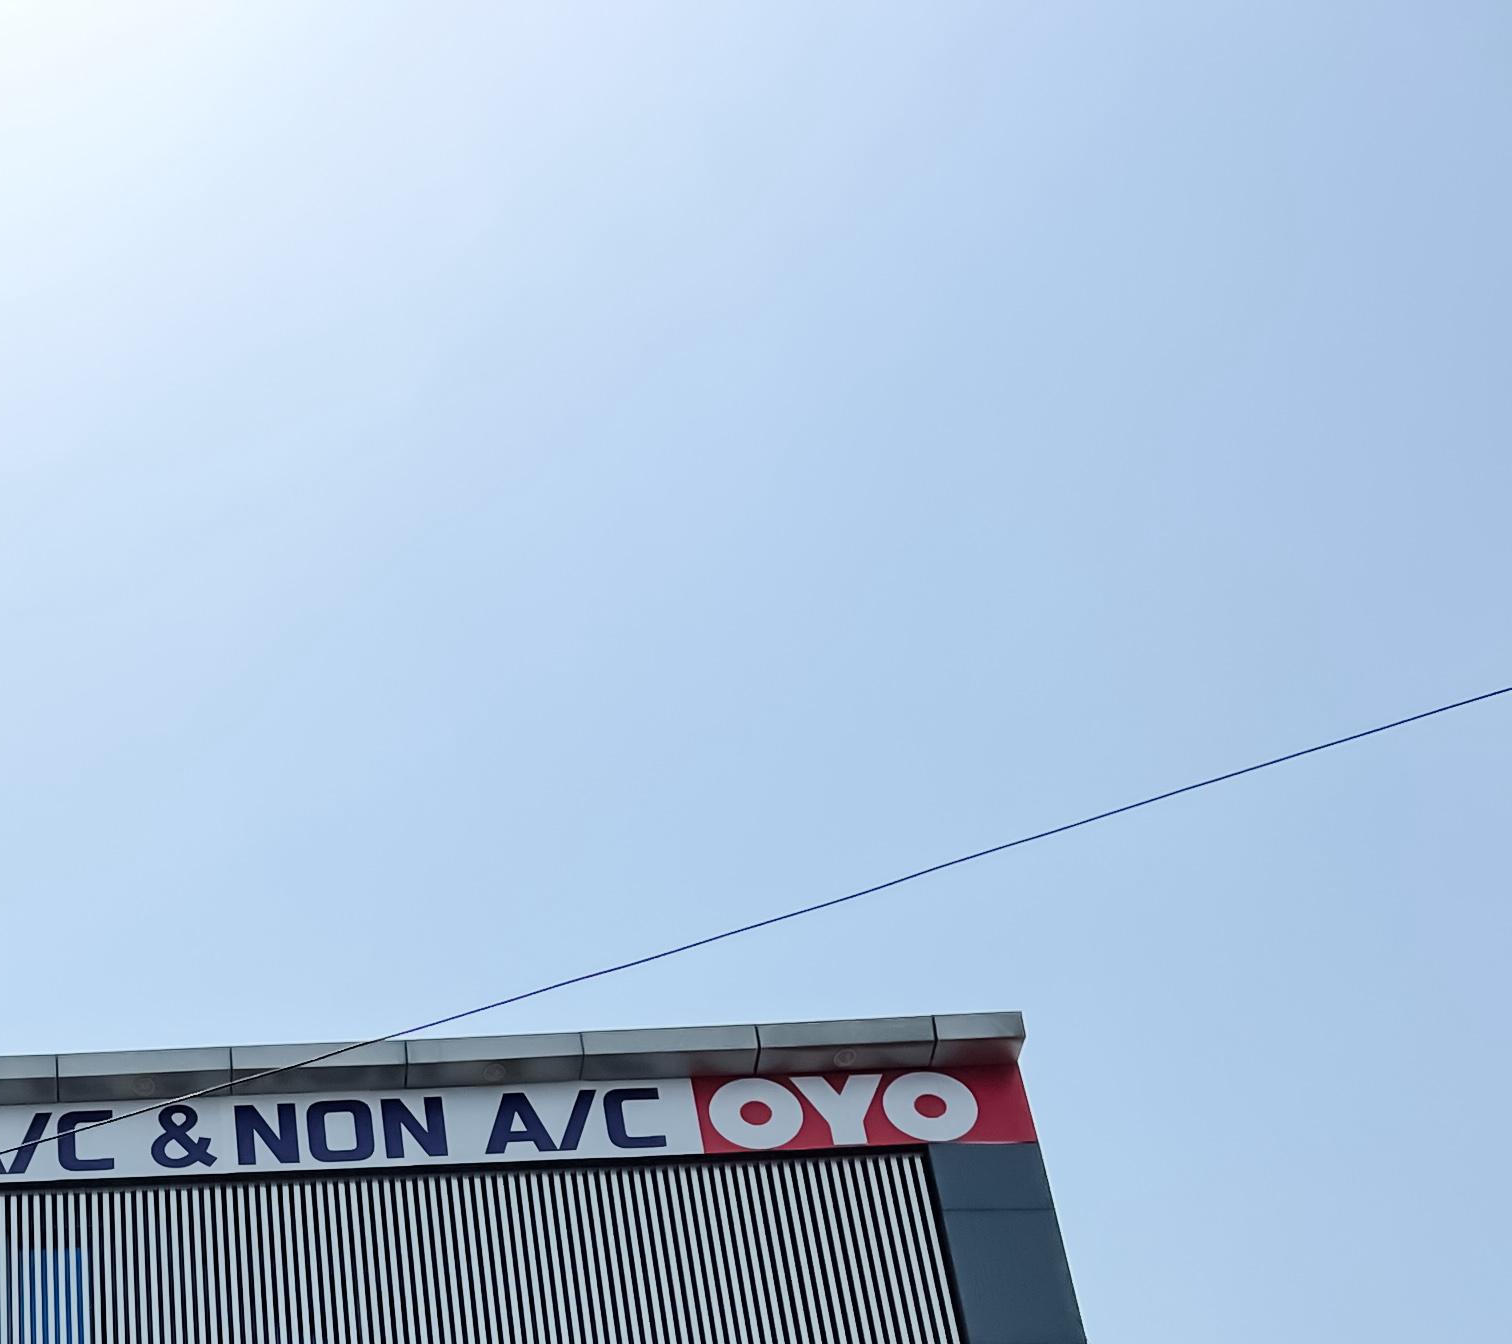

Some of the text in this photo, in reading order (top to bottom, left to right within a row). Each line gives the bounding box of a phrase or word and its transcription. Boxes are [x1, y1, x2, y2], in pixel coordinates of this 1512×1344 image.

[150, 1104, 218, 1168] &
[234, 1096, 449, 1165] NON
[485, 1087, 667, 1155] A/C
[708, 1071, 979, 1150] OYO
